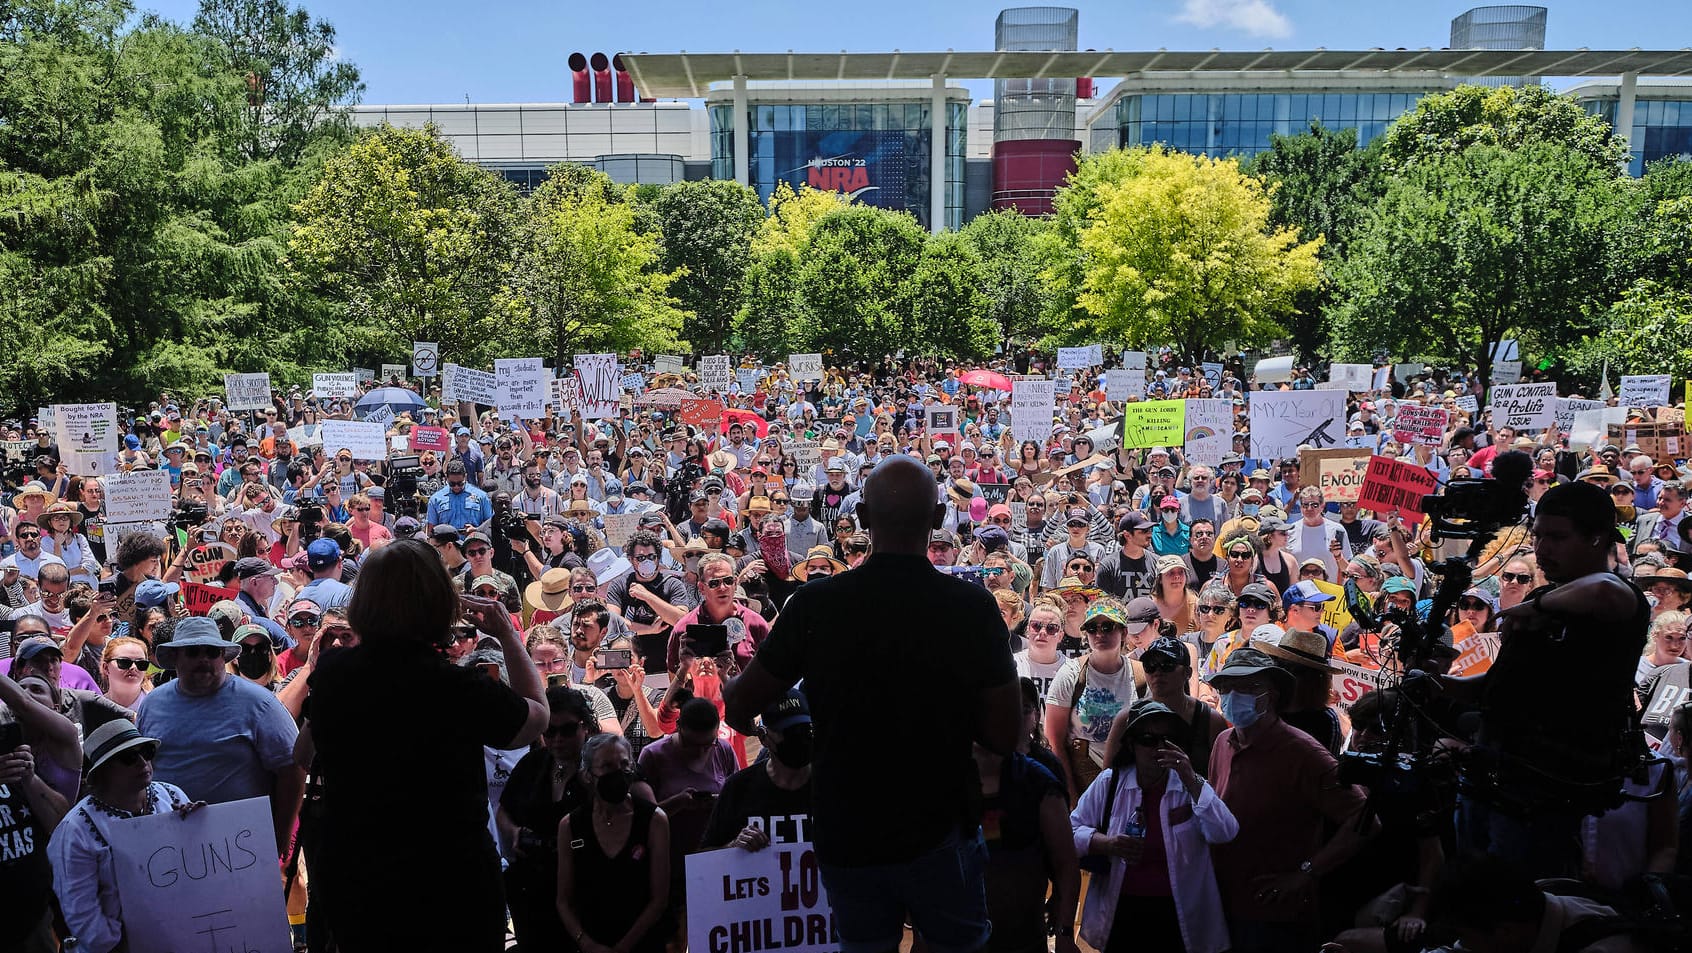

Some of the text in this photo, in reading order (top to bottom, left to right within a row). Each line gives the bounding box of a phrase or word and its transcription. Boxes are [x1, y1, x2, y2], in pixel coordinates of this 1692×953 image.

[852, 158, 866, 167] '22
[808, 167, 870, 193] NRA
[791, 360, 821, 373] WORKS
[703, 385, 727, 393] CNGE
[1494, 385, 1554, 400] GUN CONTROL
[60, 406, 84, 414] Bought
[1253, 399, 1344, 418] MY 2 Year Old
[1568, 401, 1592, 411] BAN
[1373, 461, 1390, 476] TEXT
[1389, 462, 1405, 483] ACT
[1402, 470, 1412, 482] TO
[192, 547, 224, 563] GUN
[191, 560, 227, 576] EFO
[1121, 571, 1150, 588] TX
[186, 586, 230, 606] ACT TO 64
[1342, 666, 1358, 680] NOW
[1361, 673, 1369, 681] IS
[779, 698, 801, 711] NAVY
[747, 814, 813, 844] ET
[147, 829, 257, 888] GUNS
